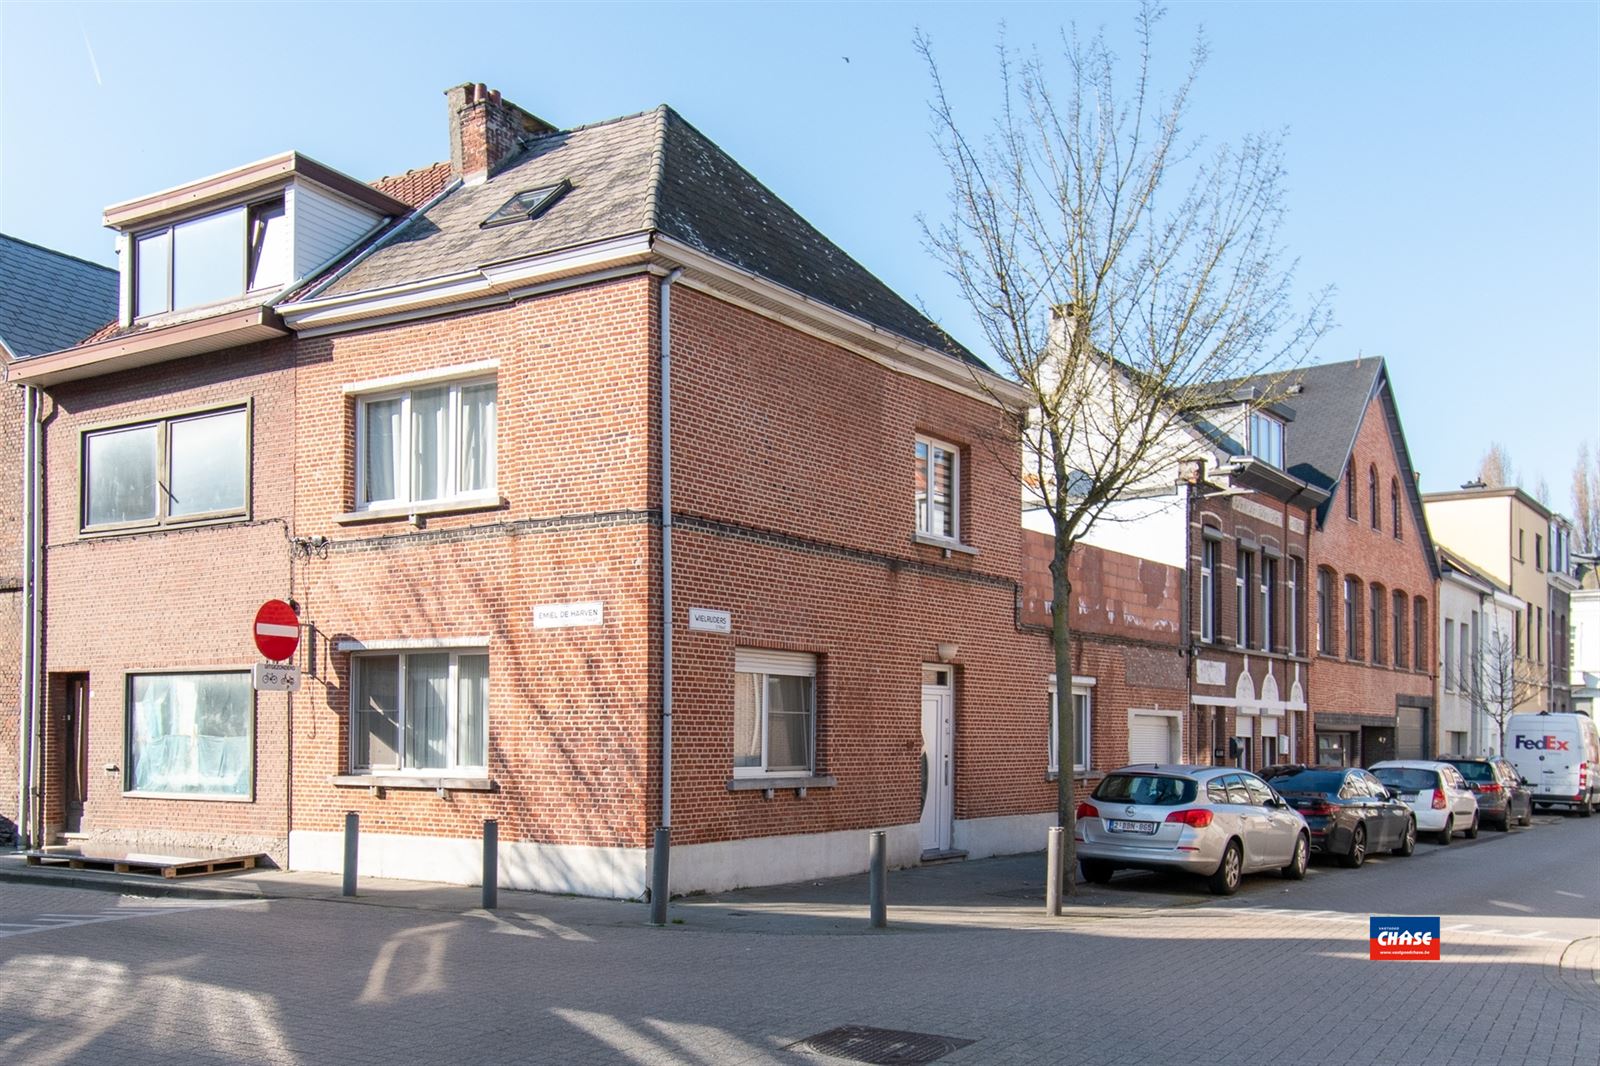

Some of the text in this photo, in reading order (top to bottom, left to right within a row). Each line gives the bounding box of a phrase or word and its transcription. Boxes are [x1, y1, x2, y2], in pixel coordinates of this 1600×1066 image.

[538, 608, 599, 620] EMIEL DE HARVEN
[1515, 734, 1569, 751] FedEx
